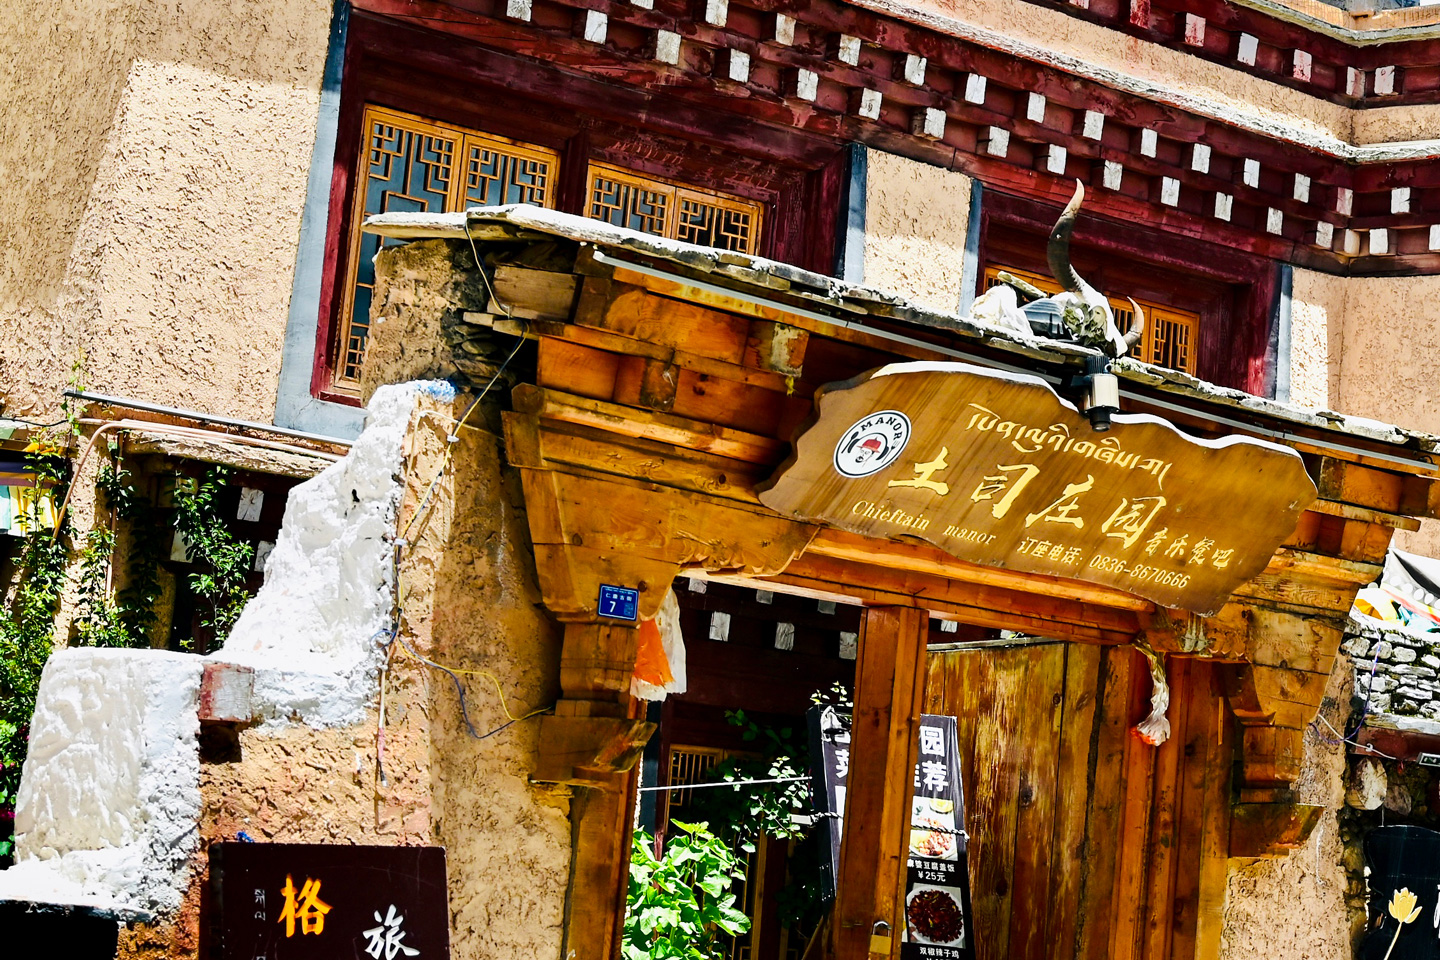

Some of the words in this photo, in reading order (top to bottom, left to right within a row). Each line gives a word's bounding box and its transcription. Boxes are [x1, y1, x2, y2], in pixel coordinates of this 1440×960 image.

[860, 416, 903, 441] MANOR
[852, 500, 931, 531] Chieftain
[942, 524, 997, 545] manor
[888, 446, 1167, 551] 土司庄园
[1144, 526, 1235, 570] 音乐餐吧
[1088, 554, 1191, 589] 0836-8670666
[609, 600, 616, 613] 7
[277, 873, 334, 938] 格
[362, 904, 421, 960] 旅
